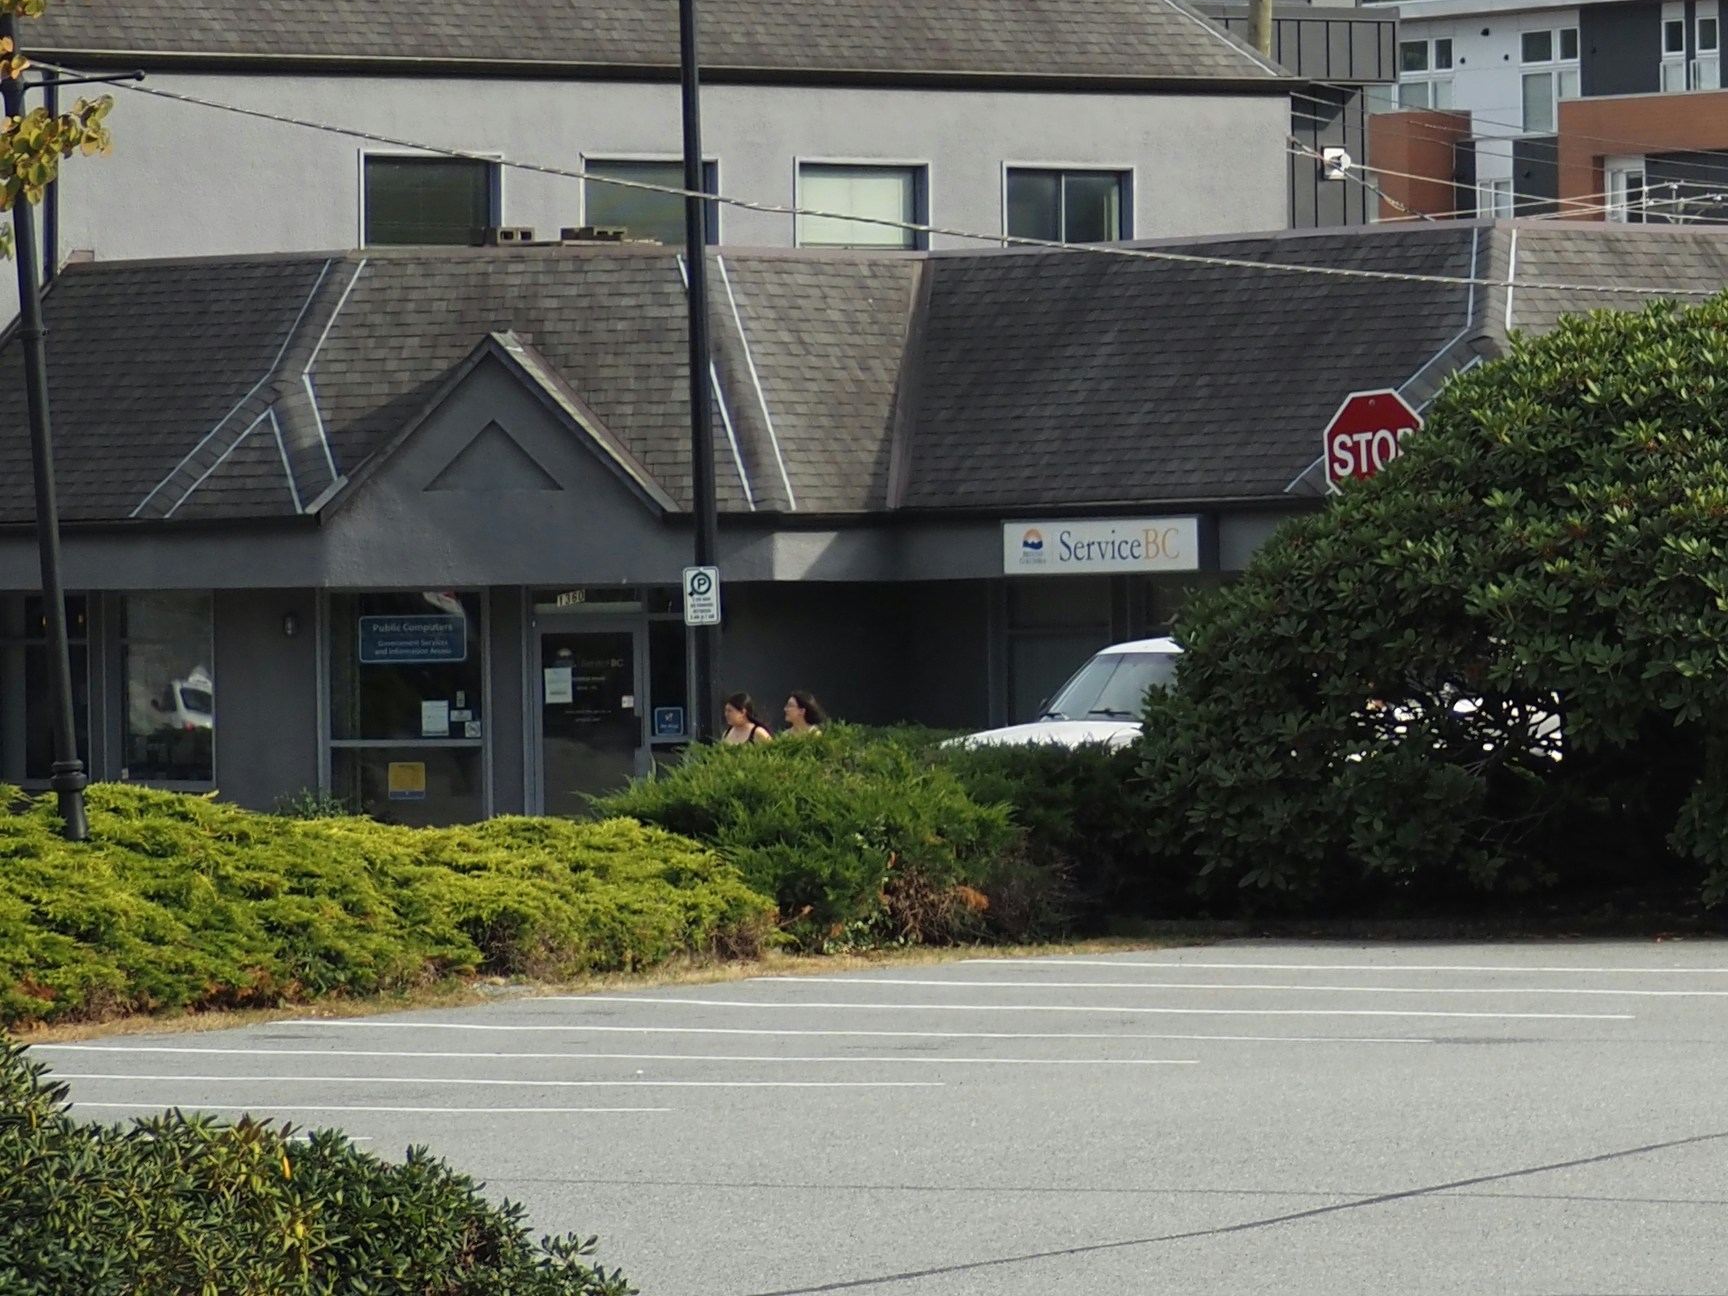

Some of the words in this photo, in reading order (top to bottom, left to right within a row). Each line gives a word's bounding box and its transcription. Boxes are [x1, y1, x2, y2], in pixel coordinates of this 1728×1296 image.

[557, 590, 585, 607] 1360
[373, 623, 401, 632] Public
[402, 623, 453, 633] Computers
